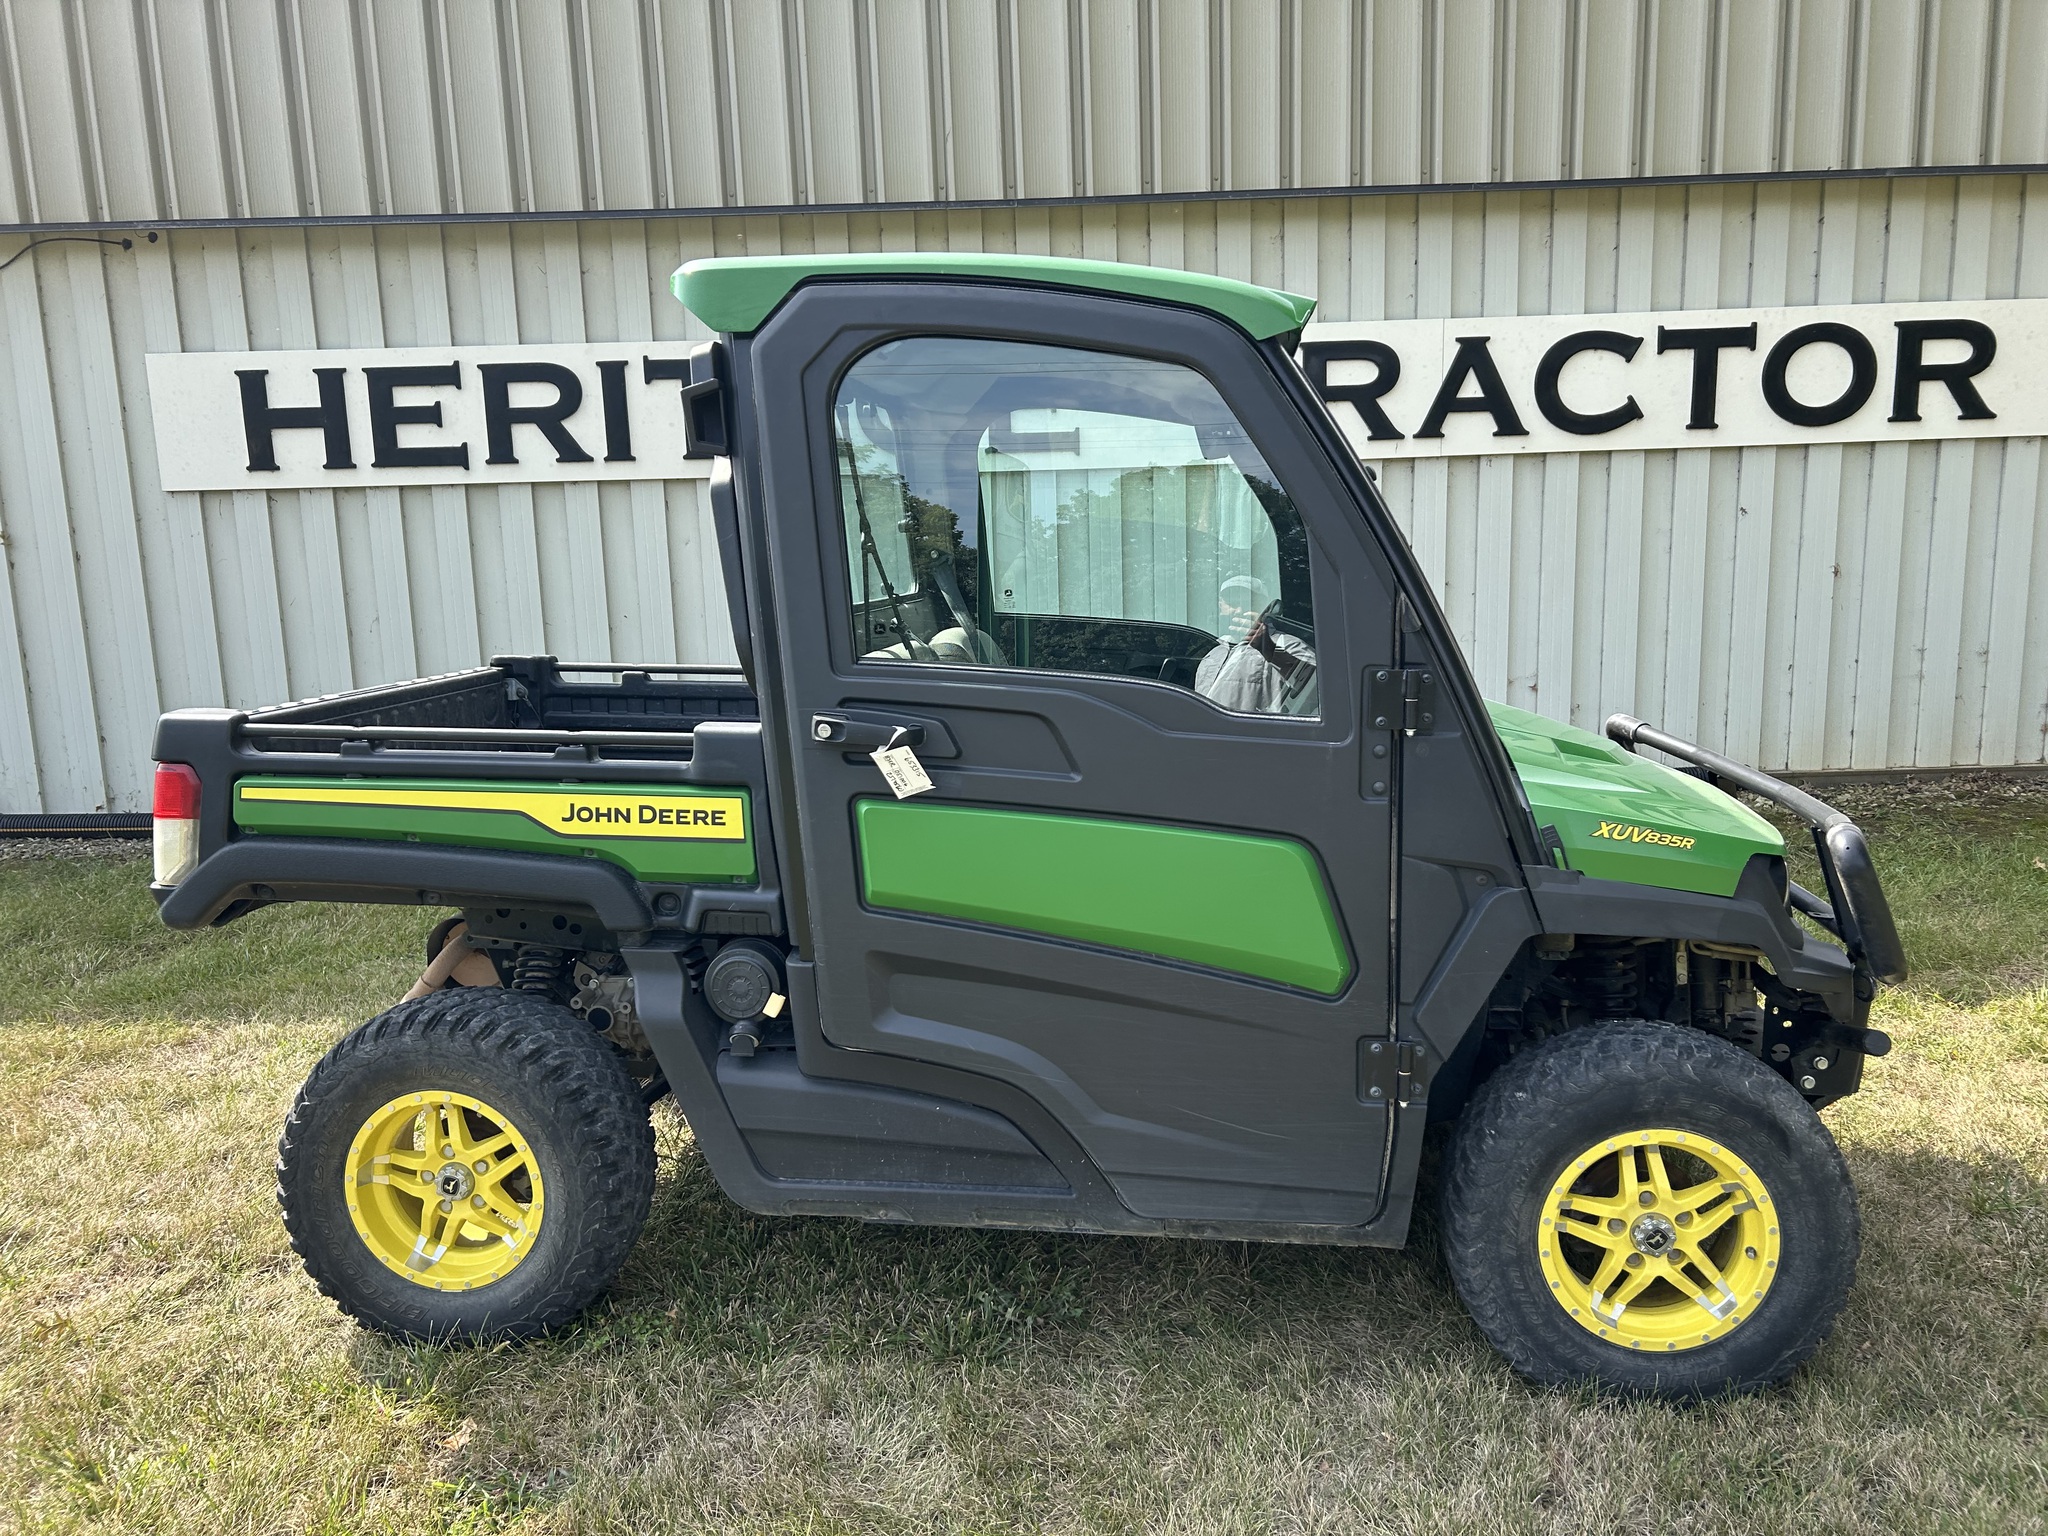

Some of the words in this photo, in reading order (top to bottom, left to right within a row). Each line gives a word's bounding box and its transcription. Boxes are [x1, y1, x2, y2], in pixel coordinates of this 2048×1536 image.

[561, 803, 631, 823] JOHN
[638, 804, 727, 826] DEERE
[1589, 820, 1696, 850] XUV835R
